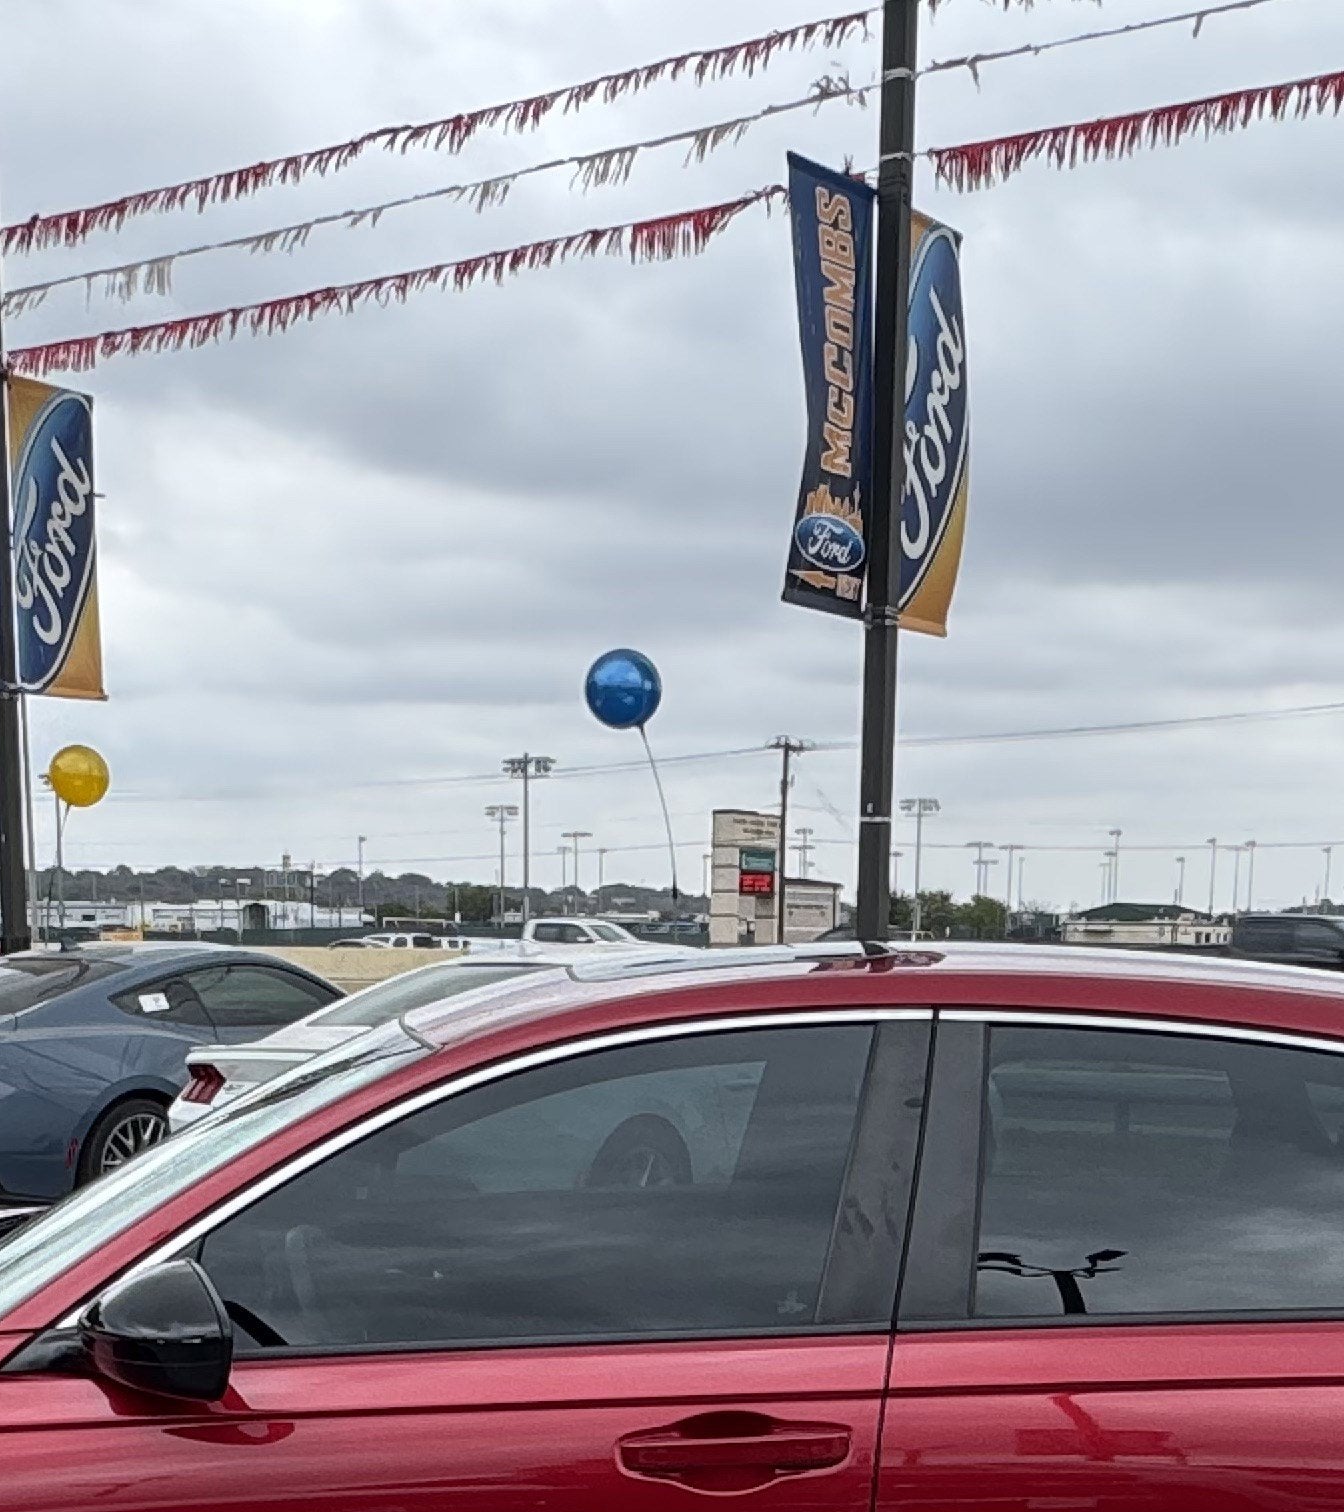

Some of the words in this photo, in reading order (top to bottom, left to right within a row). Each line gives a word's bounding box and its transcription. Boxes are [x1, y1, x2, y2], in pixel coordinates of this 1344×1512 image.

[815, 185, 856, 477] MCCOMBS
[18, 434, 91, 646] Ford
[808, 522, 853, 565] Ford
